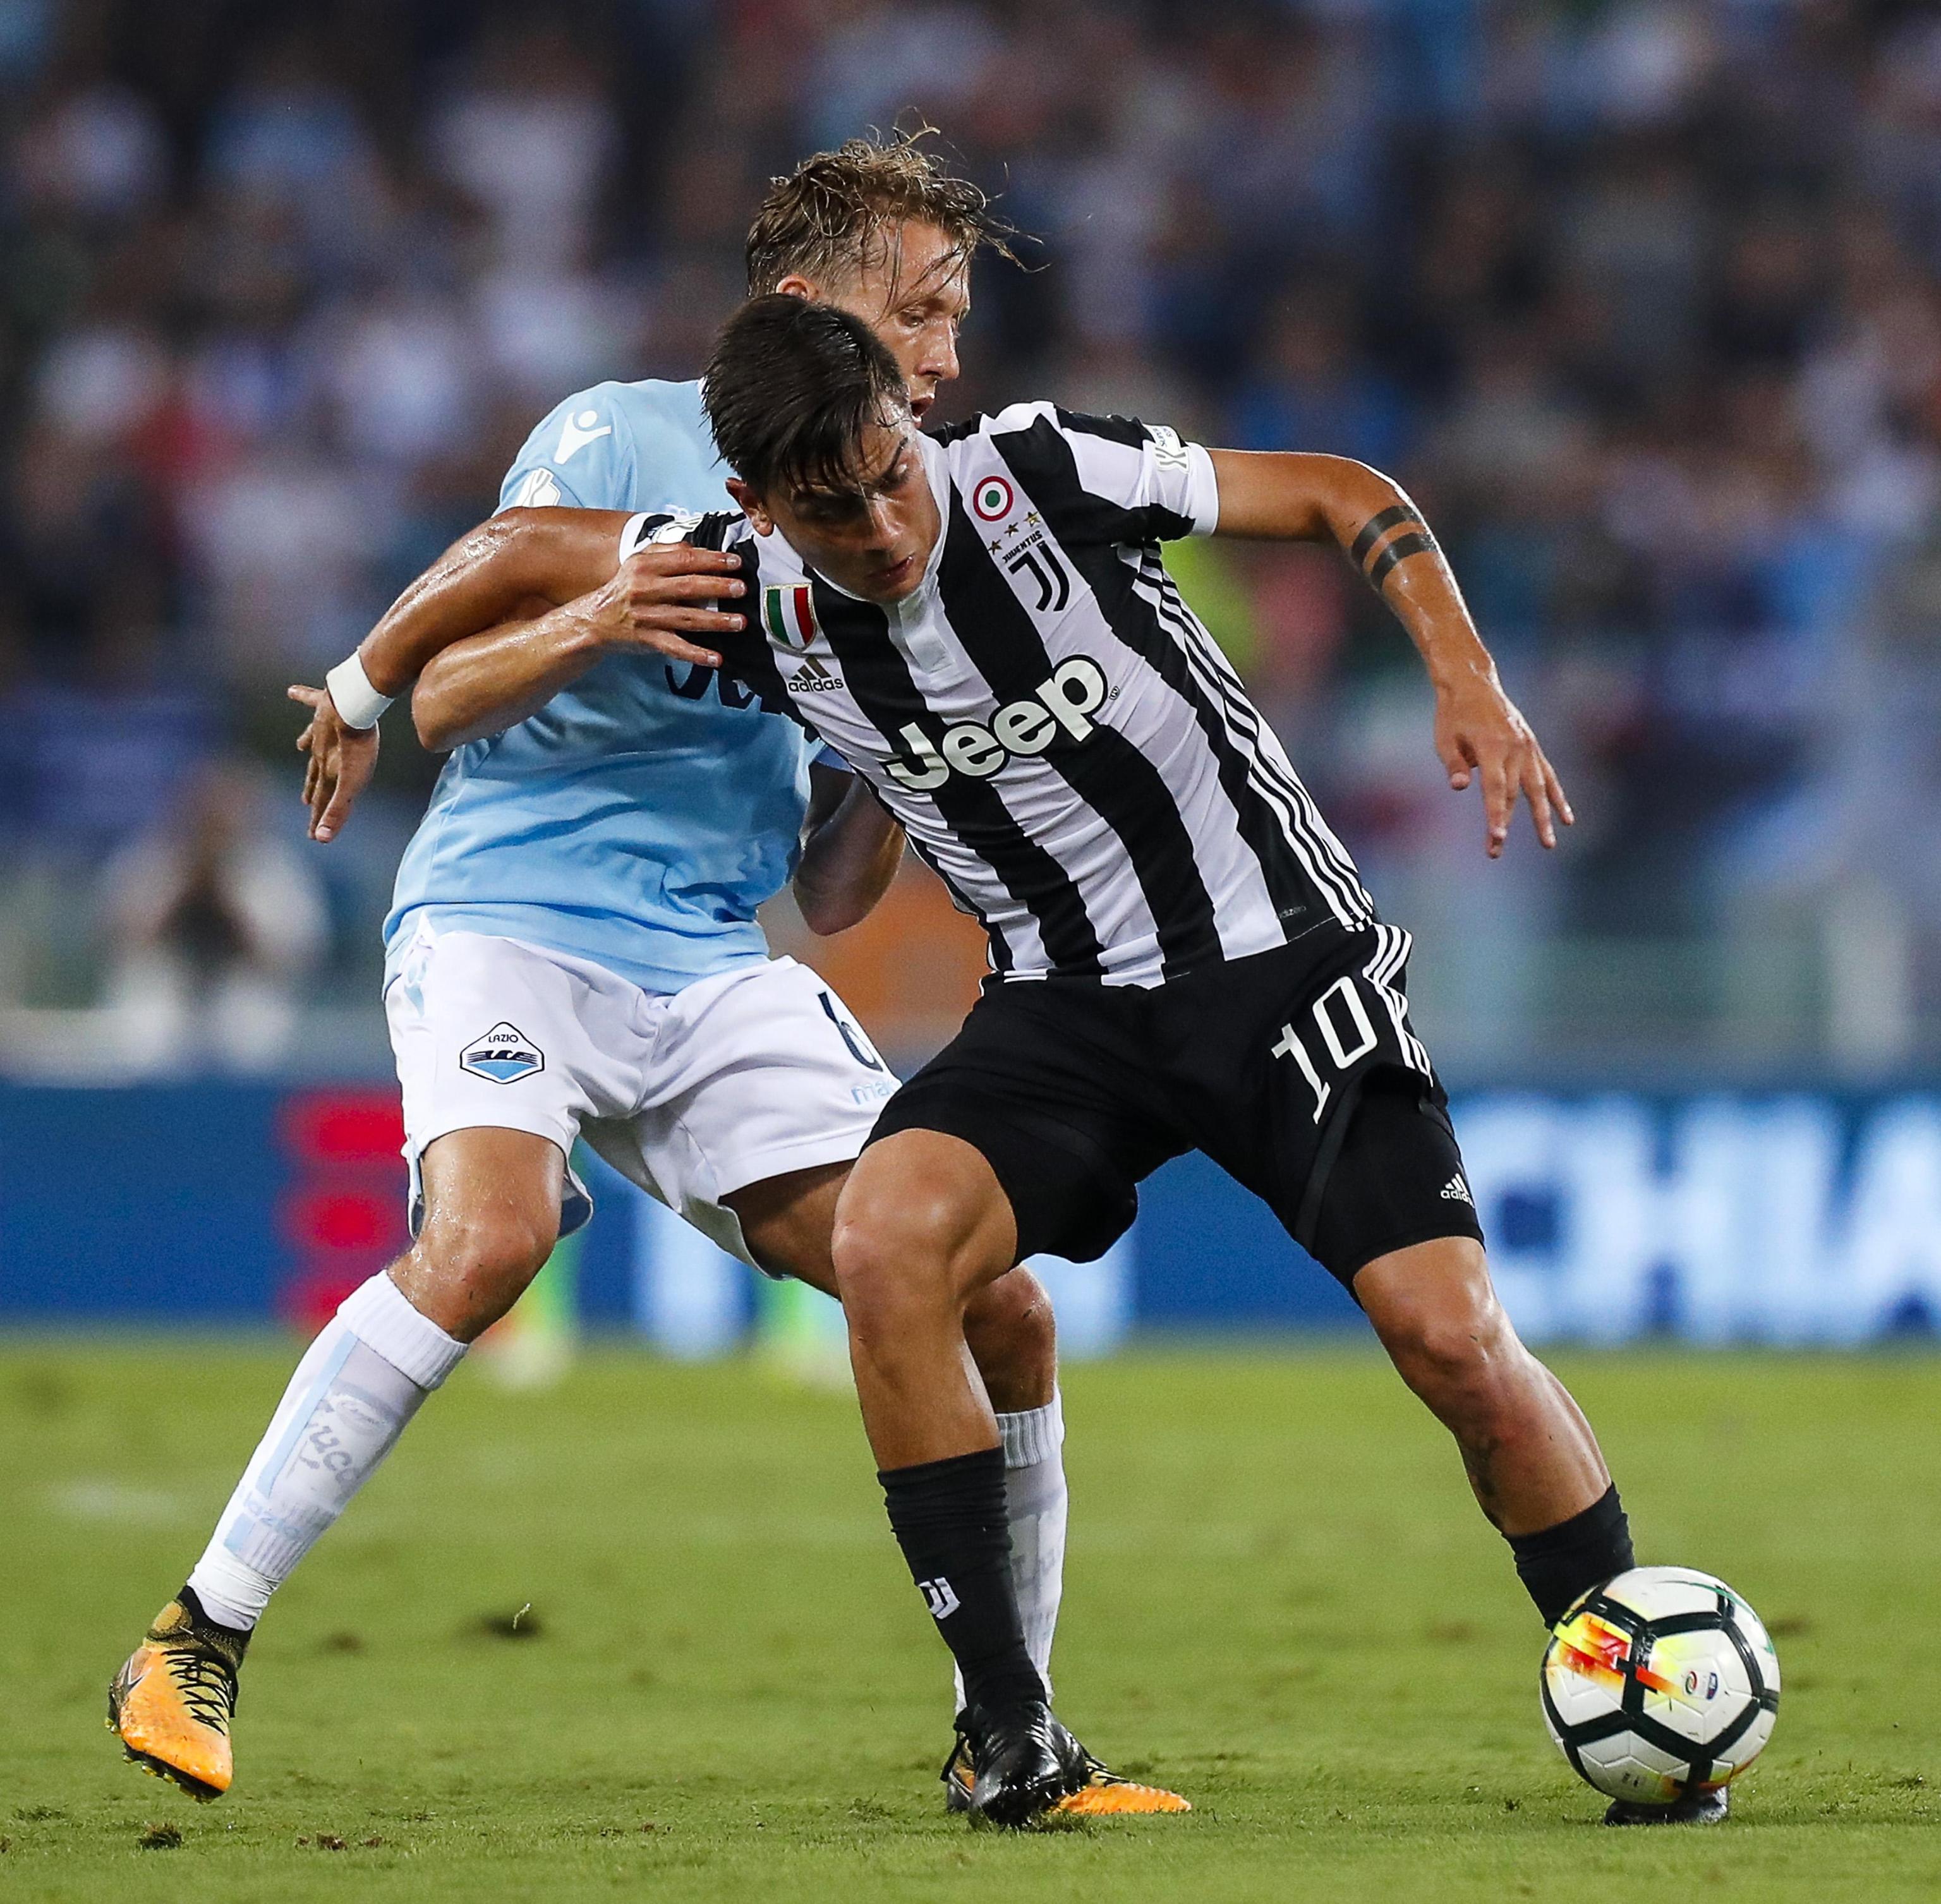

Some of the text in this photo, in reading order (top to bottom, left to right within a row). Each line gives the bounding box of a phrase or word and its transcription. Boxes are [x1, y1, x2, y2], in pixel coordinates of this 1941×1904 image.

[1001, 530, 1043, 563] JUVENTUS
[788, 678, 844, 692] adidas
[886, 659, 1105, 789] Jeep
[488, 1033, 519, 1043] LAZIO
[1271, 975, 1378, 1124] 10
